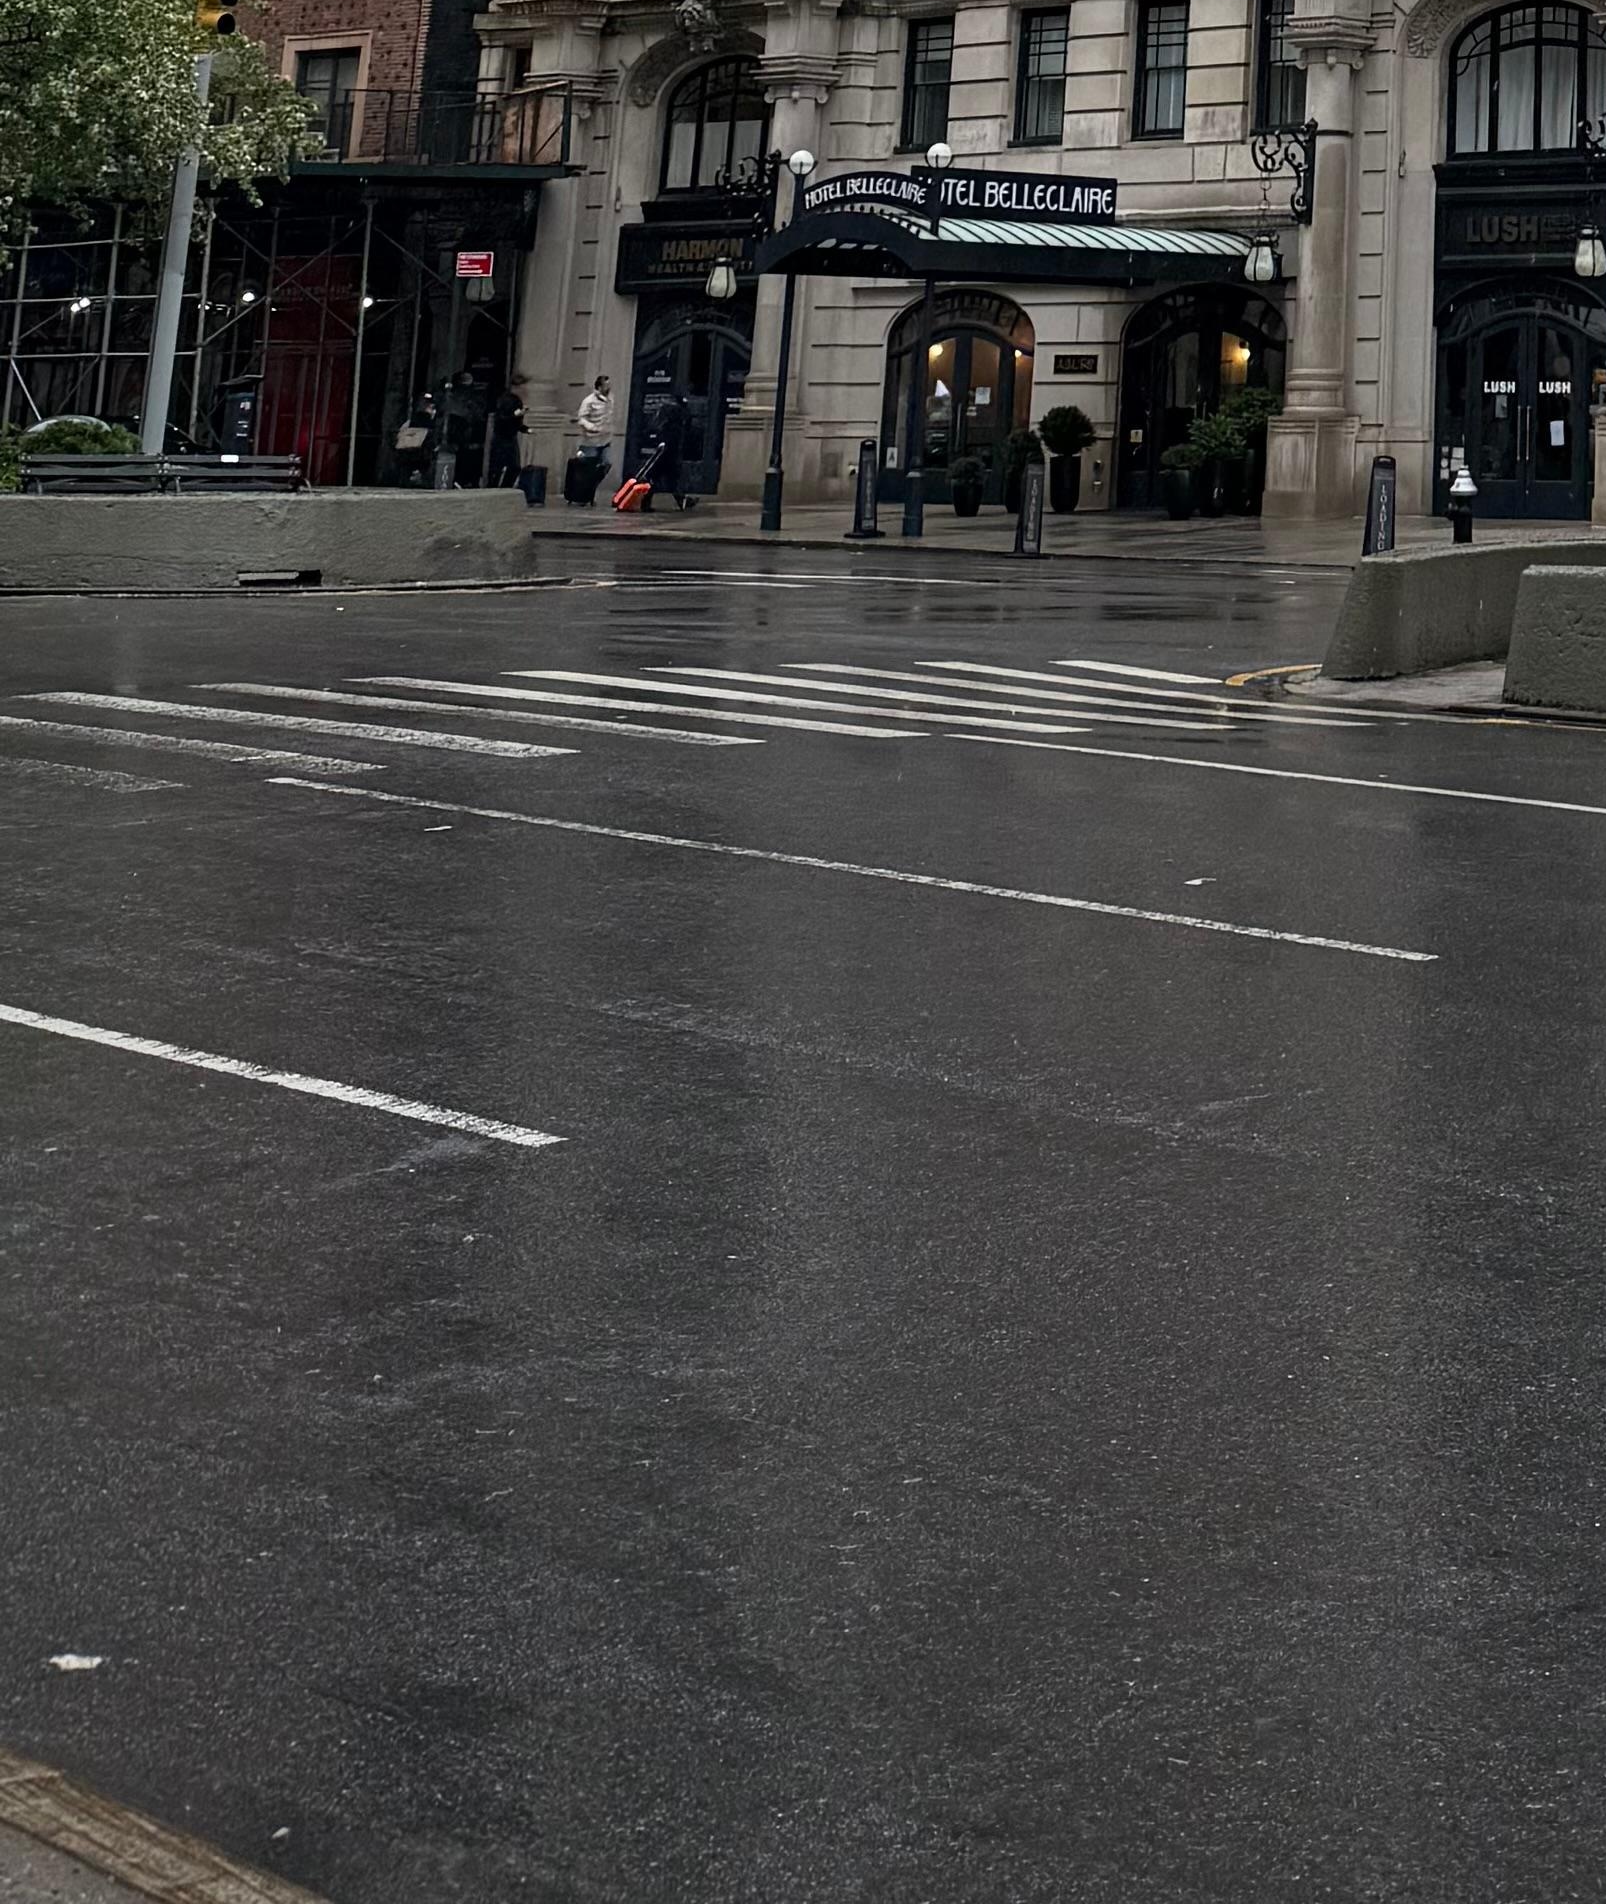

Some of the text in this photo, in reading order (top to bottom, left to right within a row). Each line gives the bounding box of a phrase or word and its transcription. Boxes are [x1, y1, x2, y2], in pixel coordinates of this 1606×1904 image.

[804, 177, 927, 210] HOTEL BELLECLAIRE
[984, 181, 1112, 214] BELLECLAIRE
[1467, 215, 1539, 242] LUSH
[661, 238, 743, 261] HARMON
[1484, 381, 1515, 393] LUSH
[1539, 382, 1571, 394] LUSH
[1377, 484, 1388, 550] LOADING
